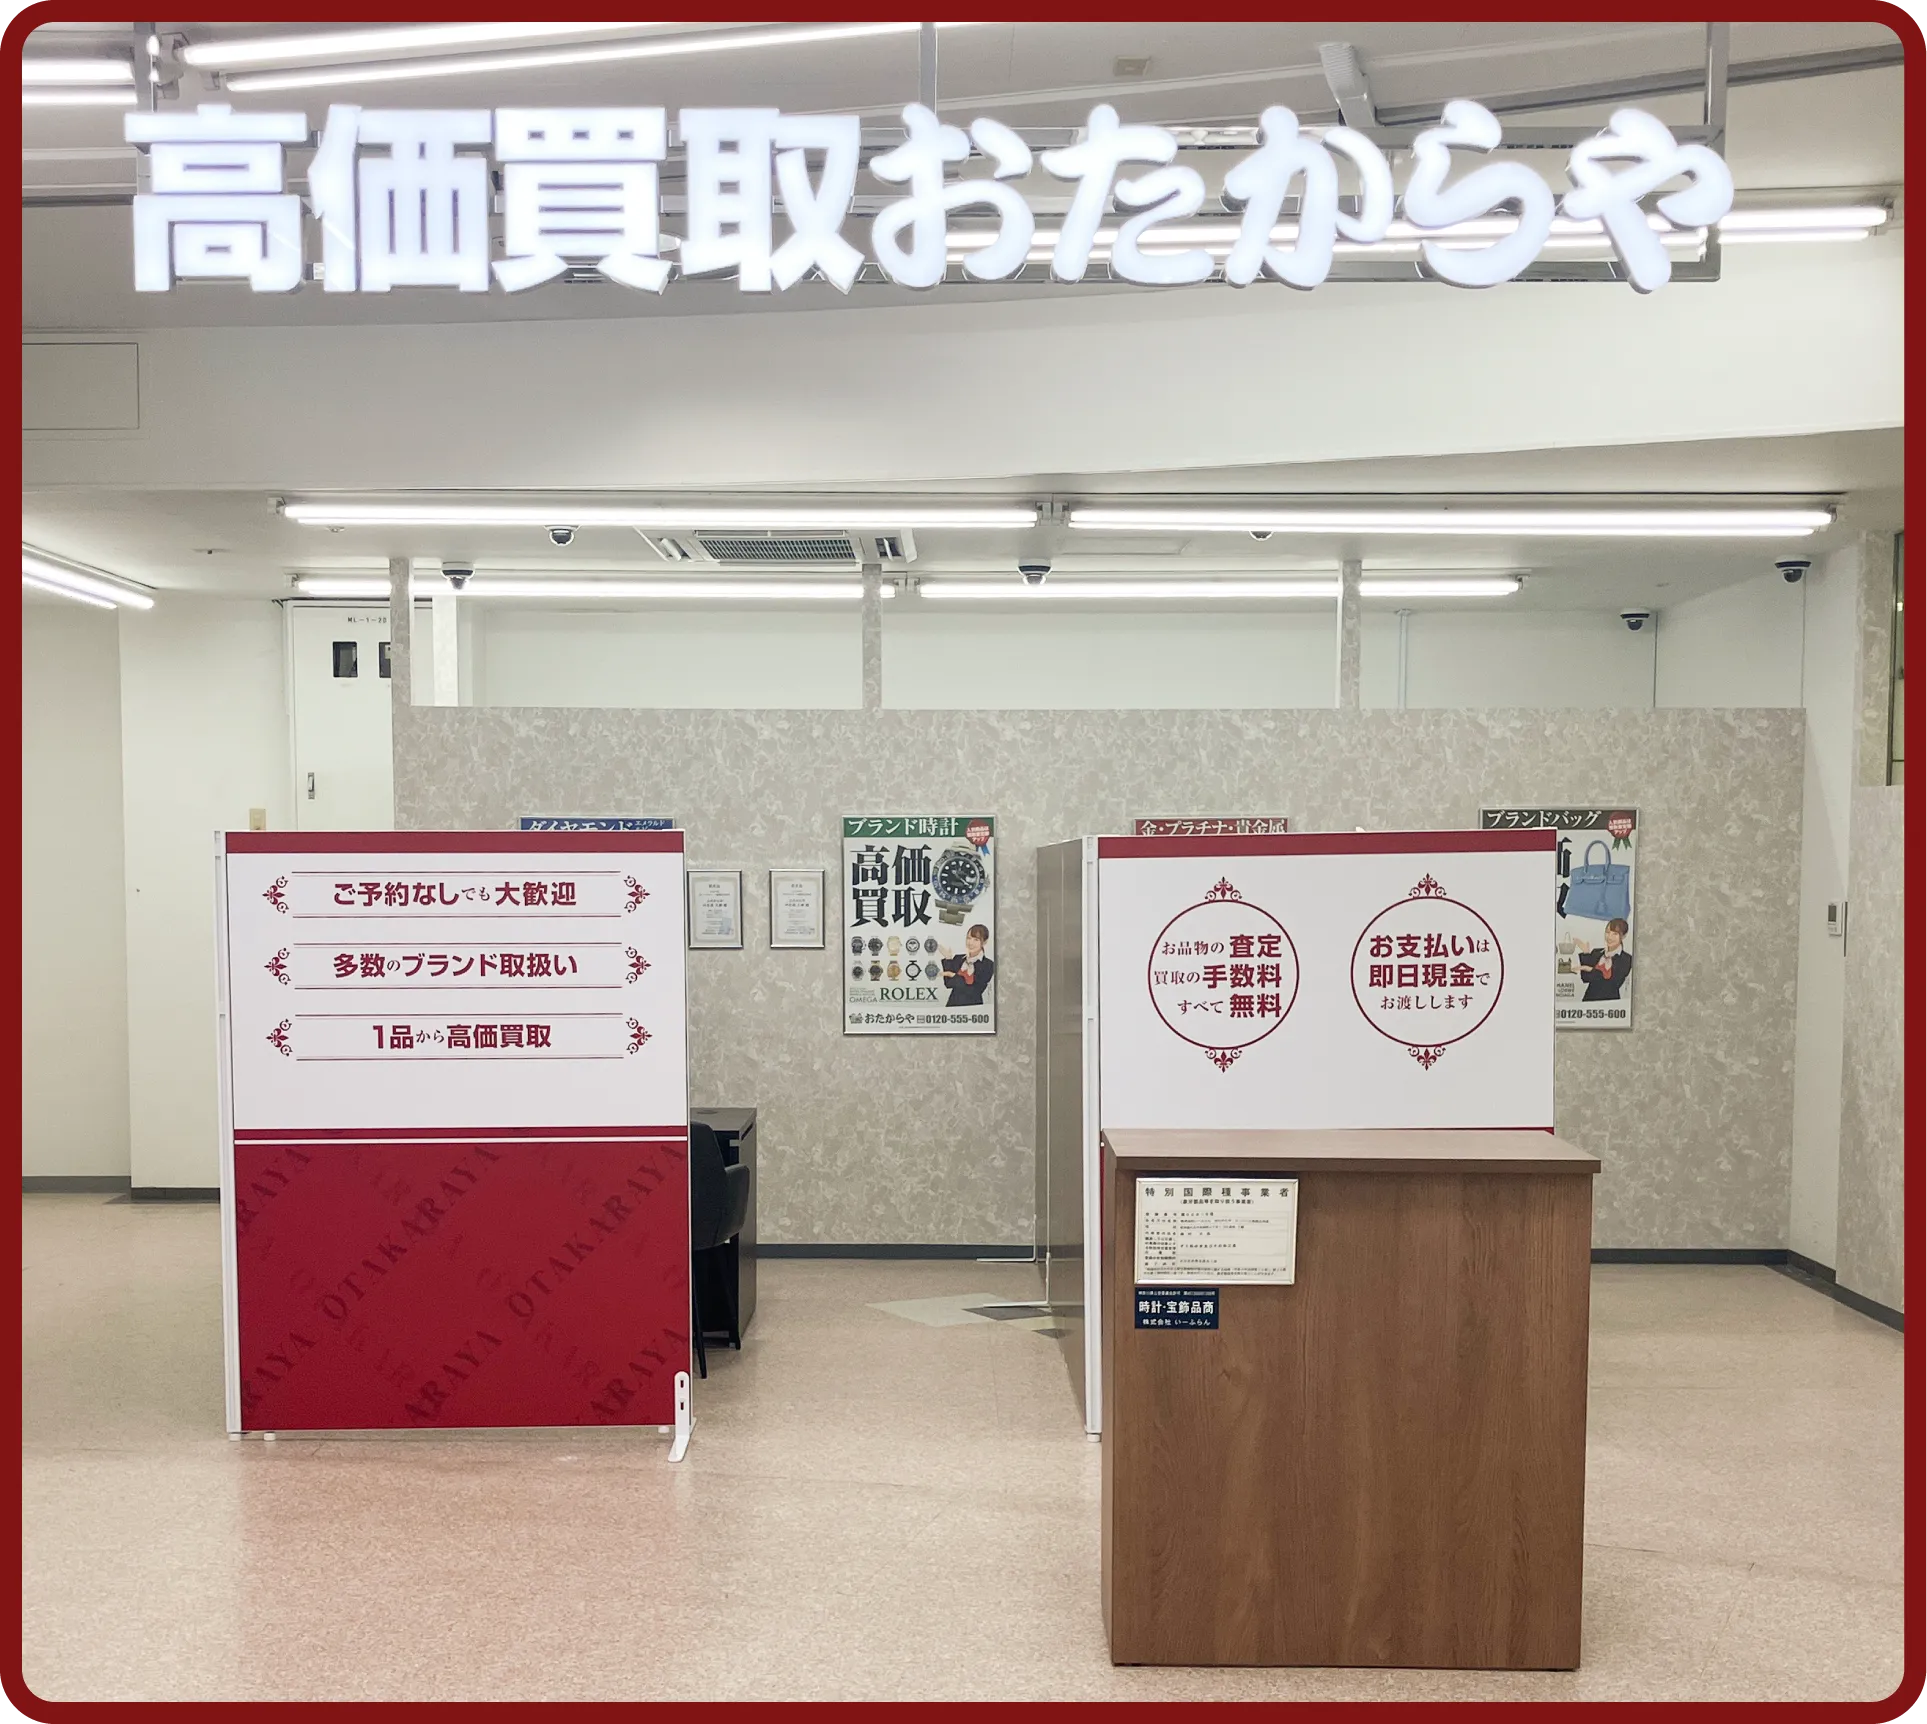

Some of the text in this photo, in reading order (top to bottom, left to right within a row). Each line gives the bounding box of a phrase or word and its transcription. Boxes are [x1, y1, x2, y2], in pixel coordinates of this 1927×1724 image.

[124, 100, 1733, 293] 高価買取おたからや
[848, 817, 959, 836] ブランド時計
[1487, 809, 1602, 828] ブランドバッグ
[850, 844, 932, 886] 高価
[333, 880, 577, 907] ご予約なしでも大歓迎
[850, 886, 933, 928] 買取
[1369, 933, 1491, 959] お支払いは
[333, 952, 578, 978] 多数のブランド取扱い
[1153, 963, 1282, 989] 買取の手数料
[1369, 962, 1491, 988] 即日現金で
[880, 987, 938, 1001] ROLEX
[1380, 994, 1473, 1011] お渡しします
[865, 1013, 915, 1024] おたからや
[926, 1014, 990, 1024] 0120-555-600
[1561, 1009, 1626, 1019] 0120-555-600
[372, 1022, 551, 1049] 1品から高価買取
[1138, 1300, 1214, 1314] 時計・宝飾品商
[1142, 1318, 1211, 1326] 株式会社 いーふらん
